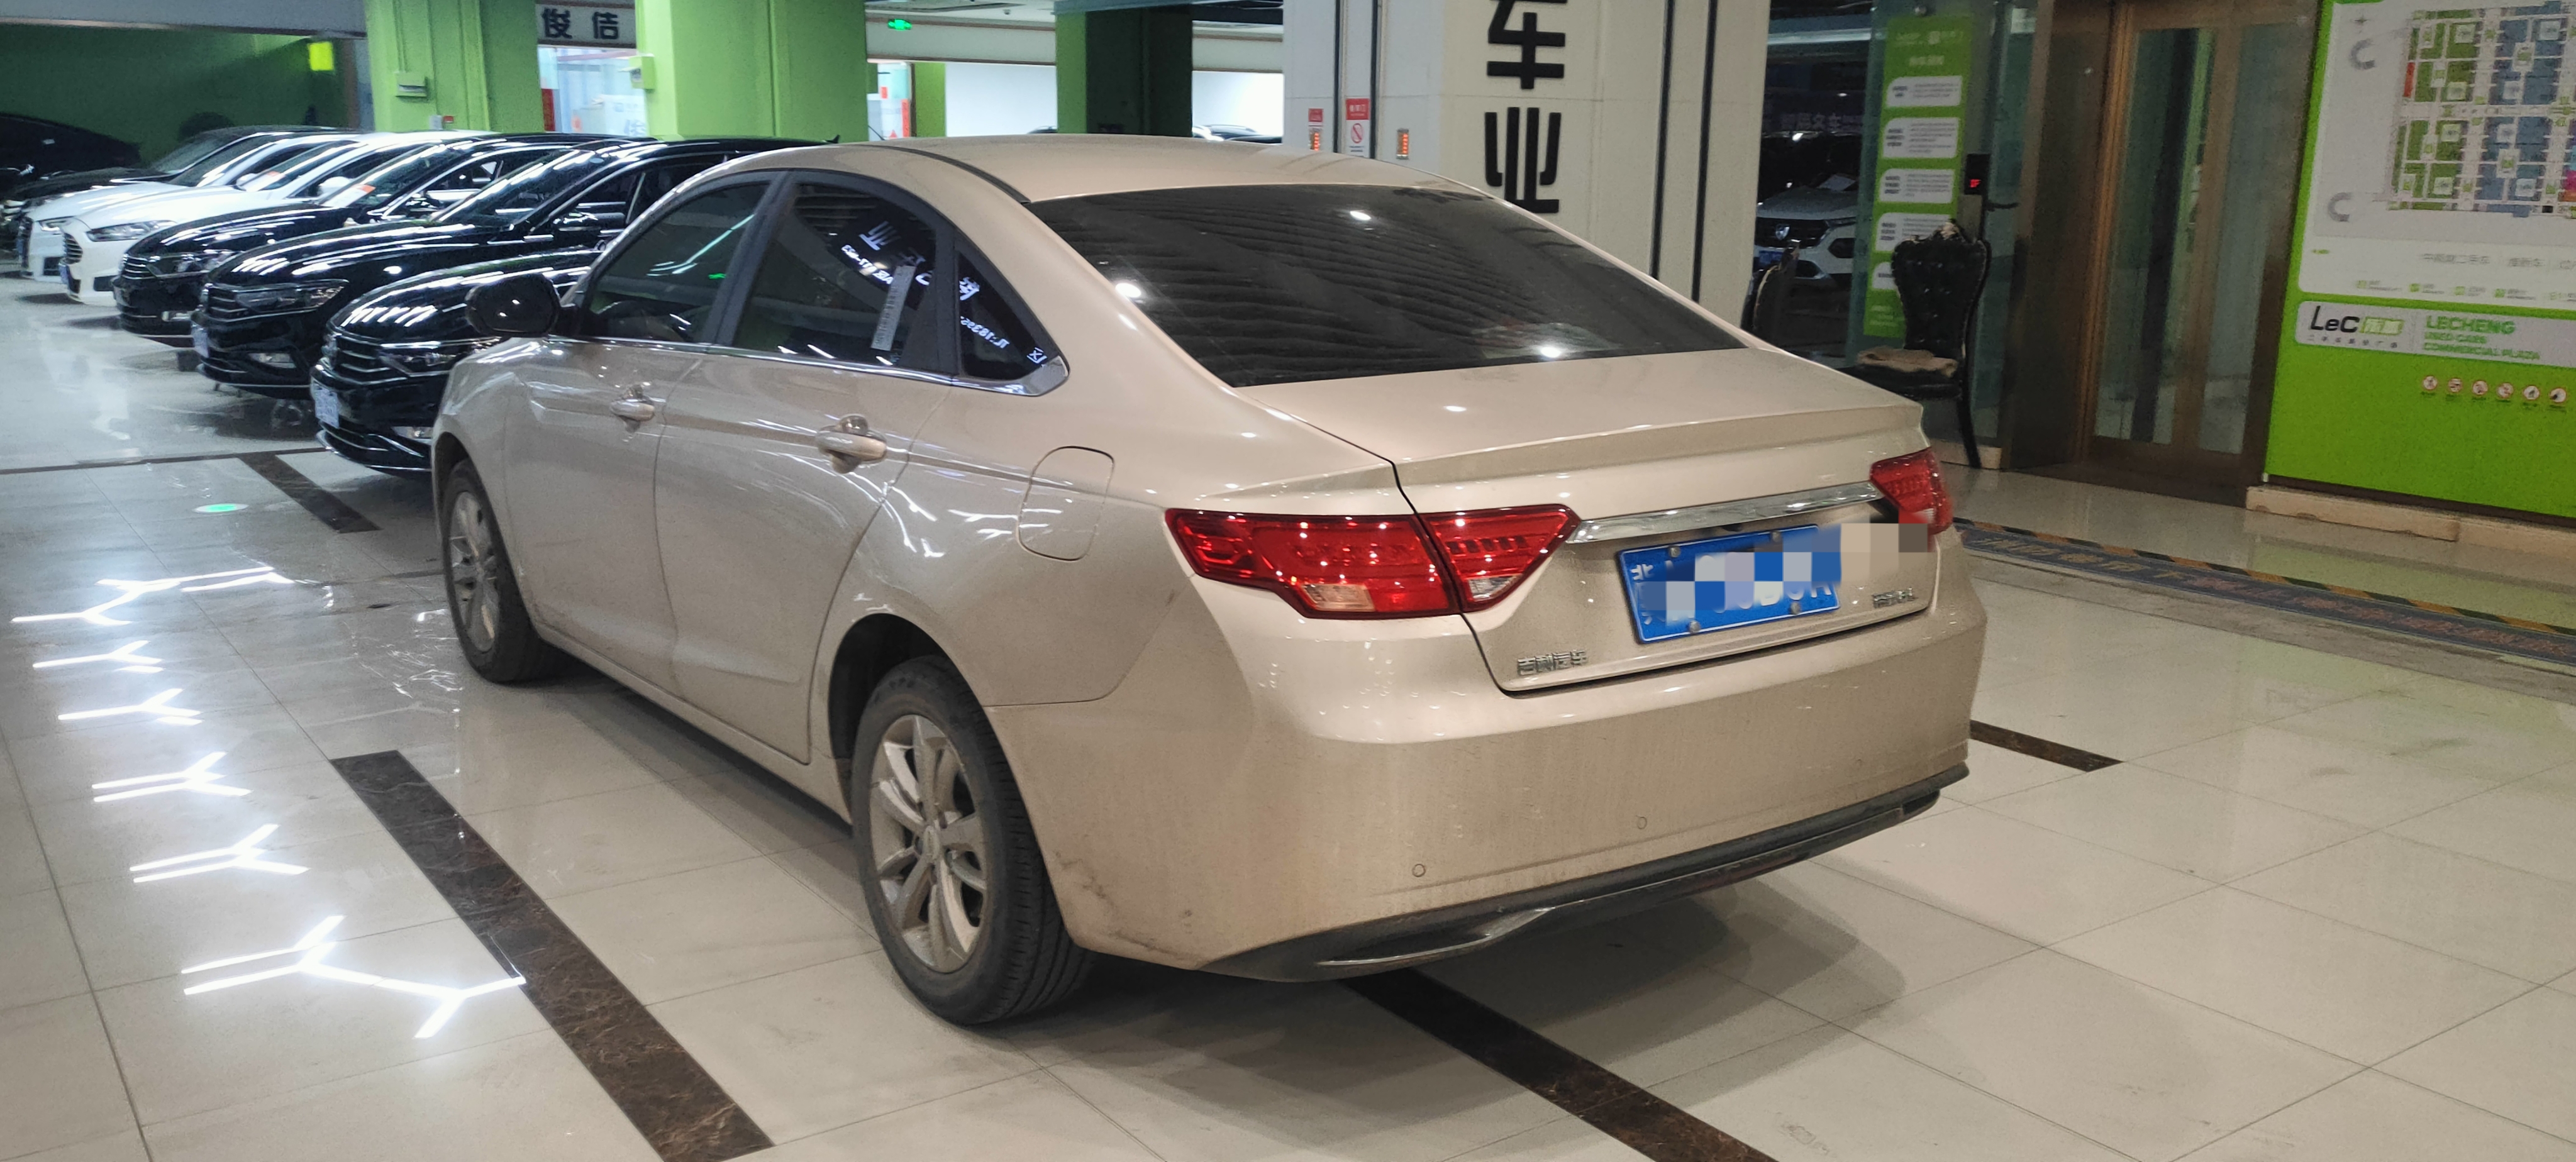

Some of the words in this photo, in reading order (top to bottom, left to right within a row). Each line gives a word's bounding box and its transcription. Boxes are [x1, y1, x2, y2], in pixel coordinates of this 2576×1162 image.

[1484, 0, 1567, 214] 车业
[2311, 306, 2360, 333] LeC
[2426, 315, 2516, 335] LECHENG
